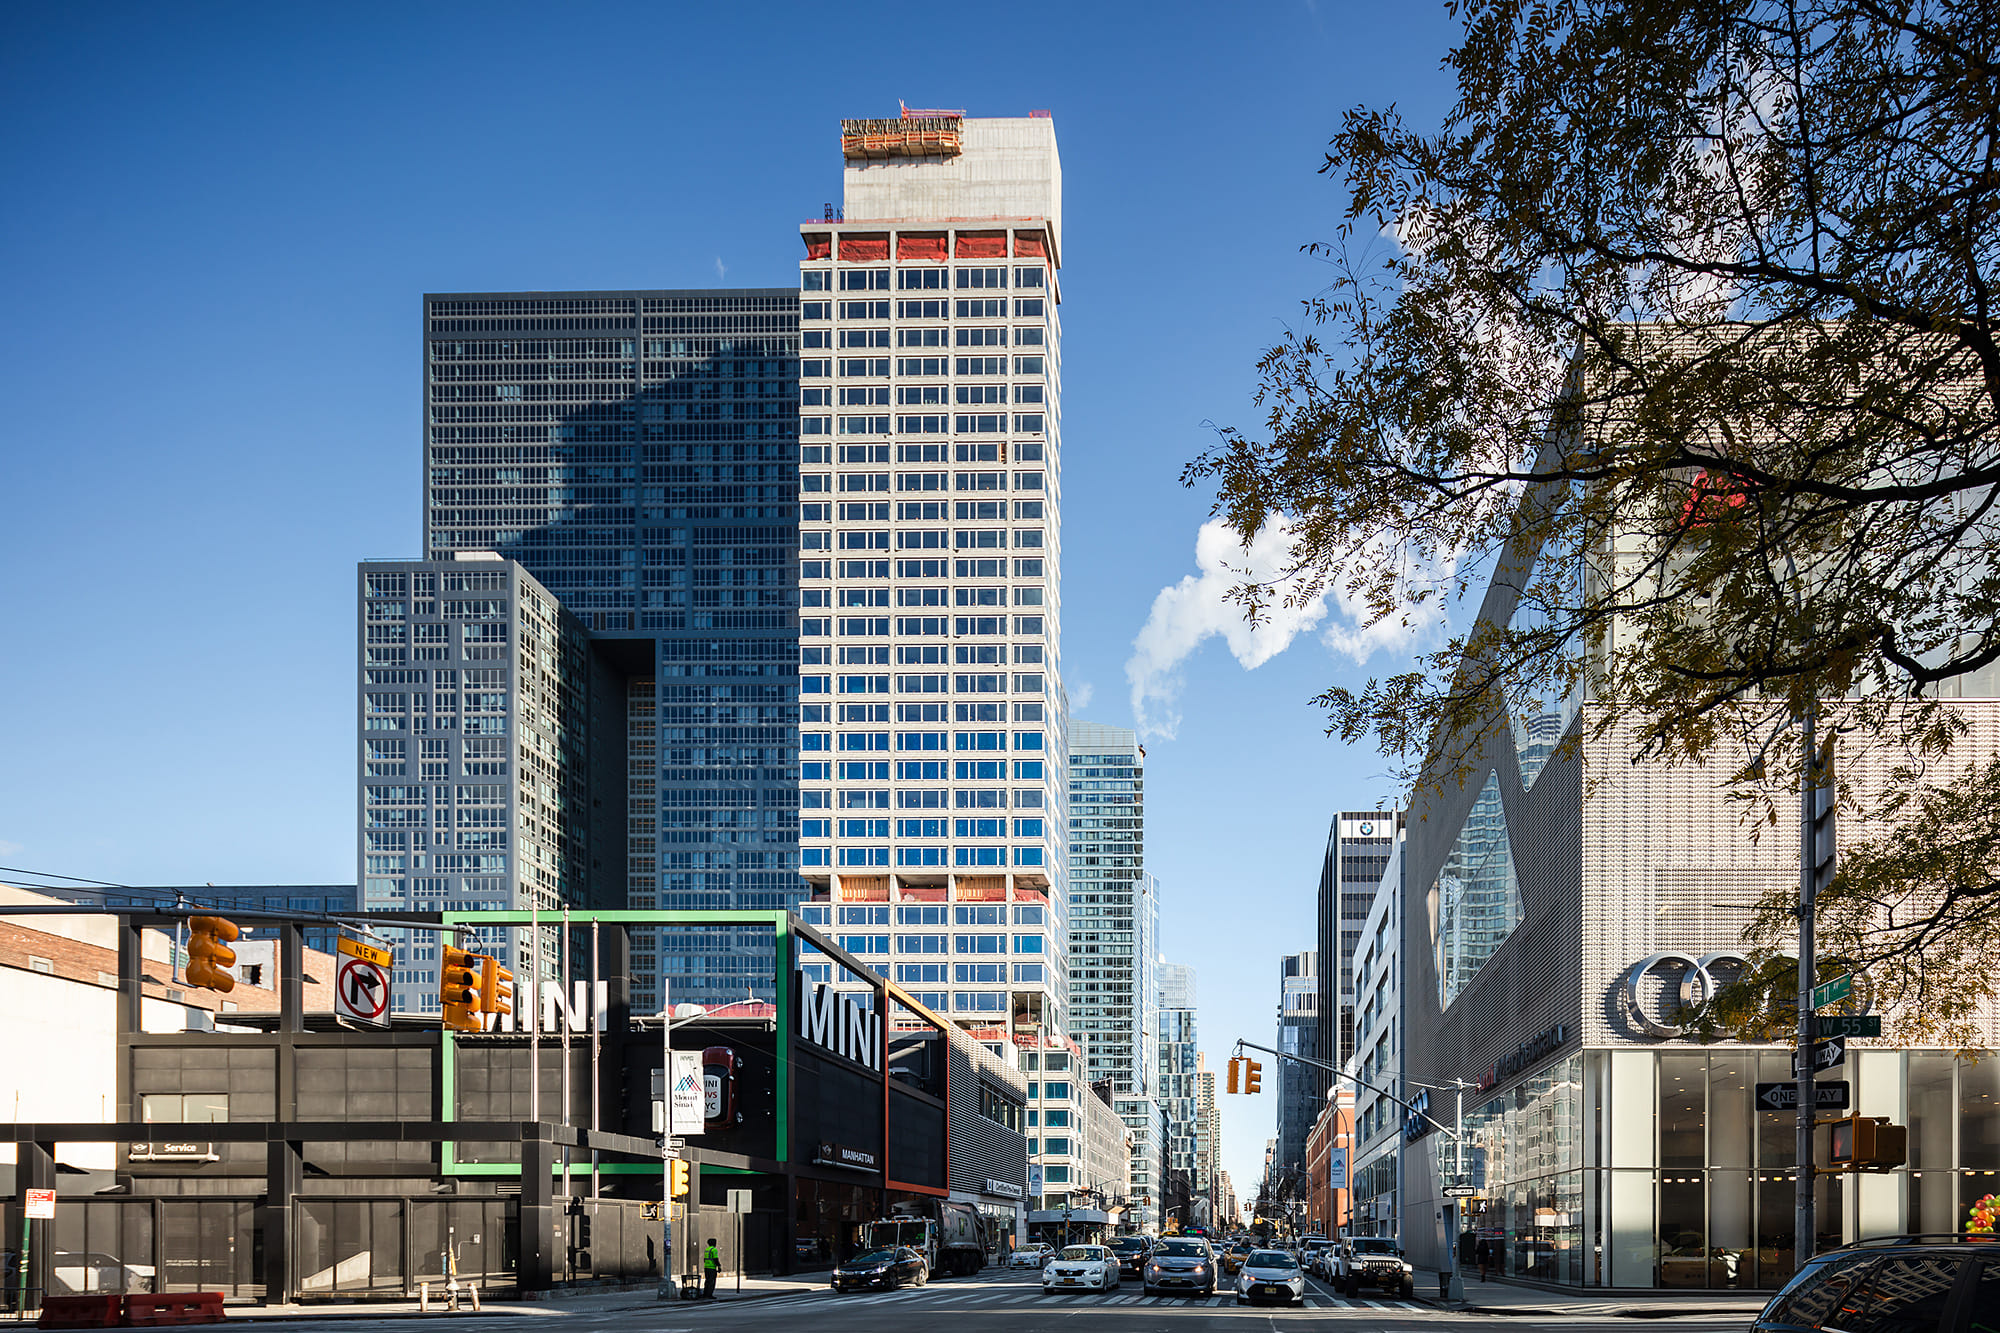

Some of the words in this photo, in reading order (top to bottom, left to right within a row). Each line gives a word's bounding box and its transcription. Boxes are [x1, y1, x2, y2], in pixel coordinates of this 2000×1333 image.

[355, 944, 378, 961] NEW
[1823, 985, 1830, 1003] 11
[1833, 981, 1840, 990] AV
[801, 970, 881, 1072] MINI
[1821, 1018, 1834, 1034] W
[1841, 1018, 1862, 1034] 55
[1868, 1018, 1879, 1027] ST
[1820, 1046, 1837, 1062] WAY
[704, 1080, 718, 1088] INI
[1770, 1090, 1796, 1102] ONE
[1815, 1089, 1837, 1101] AY
[704, 1102, 717, 1110] YC
[163, 1143, 197, 1152] Service
[842, 1148, 875, 1165] MANHATTAN
